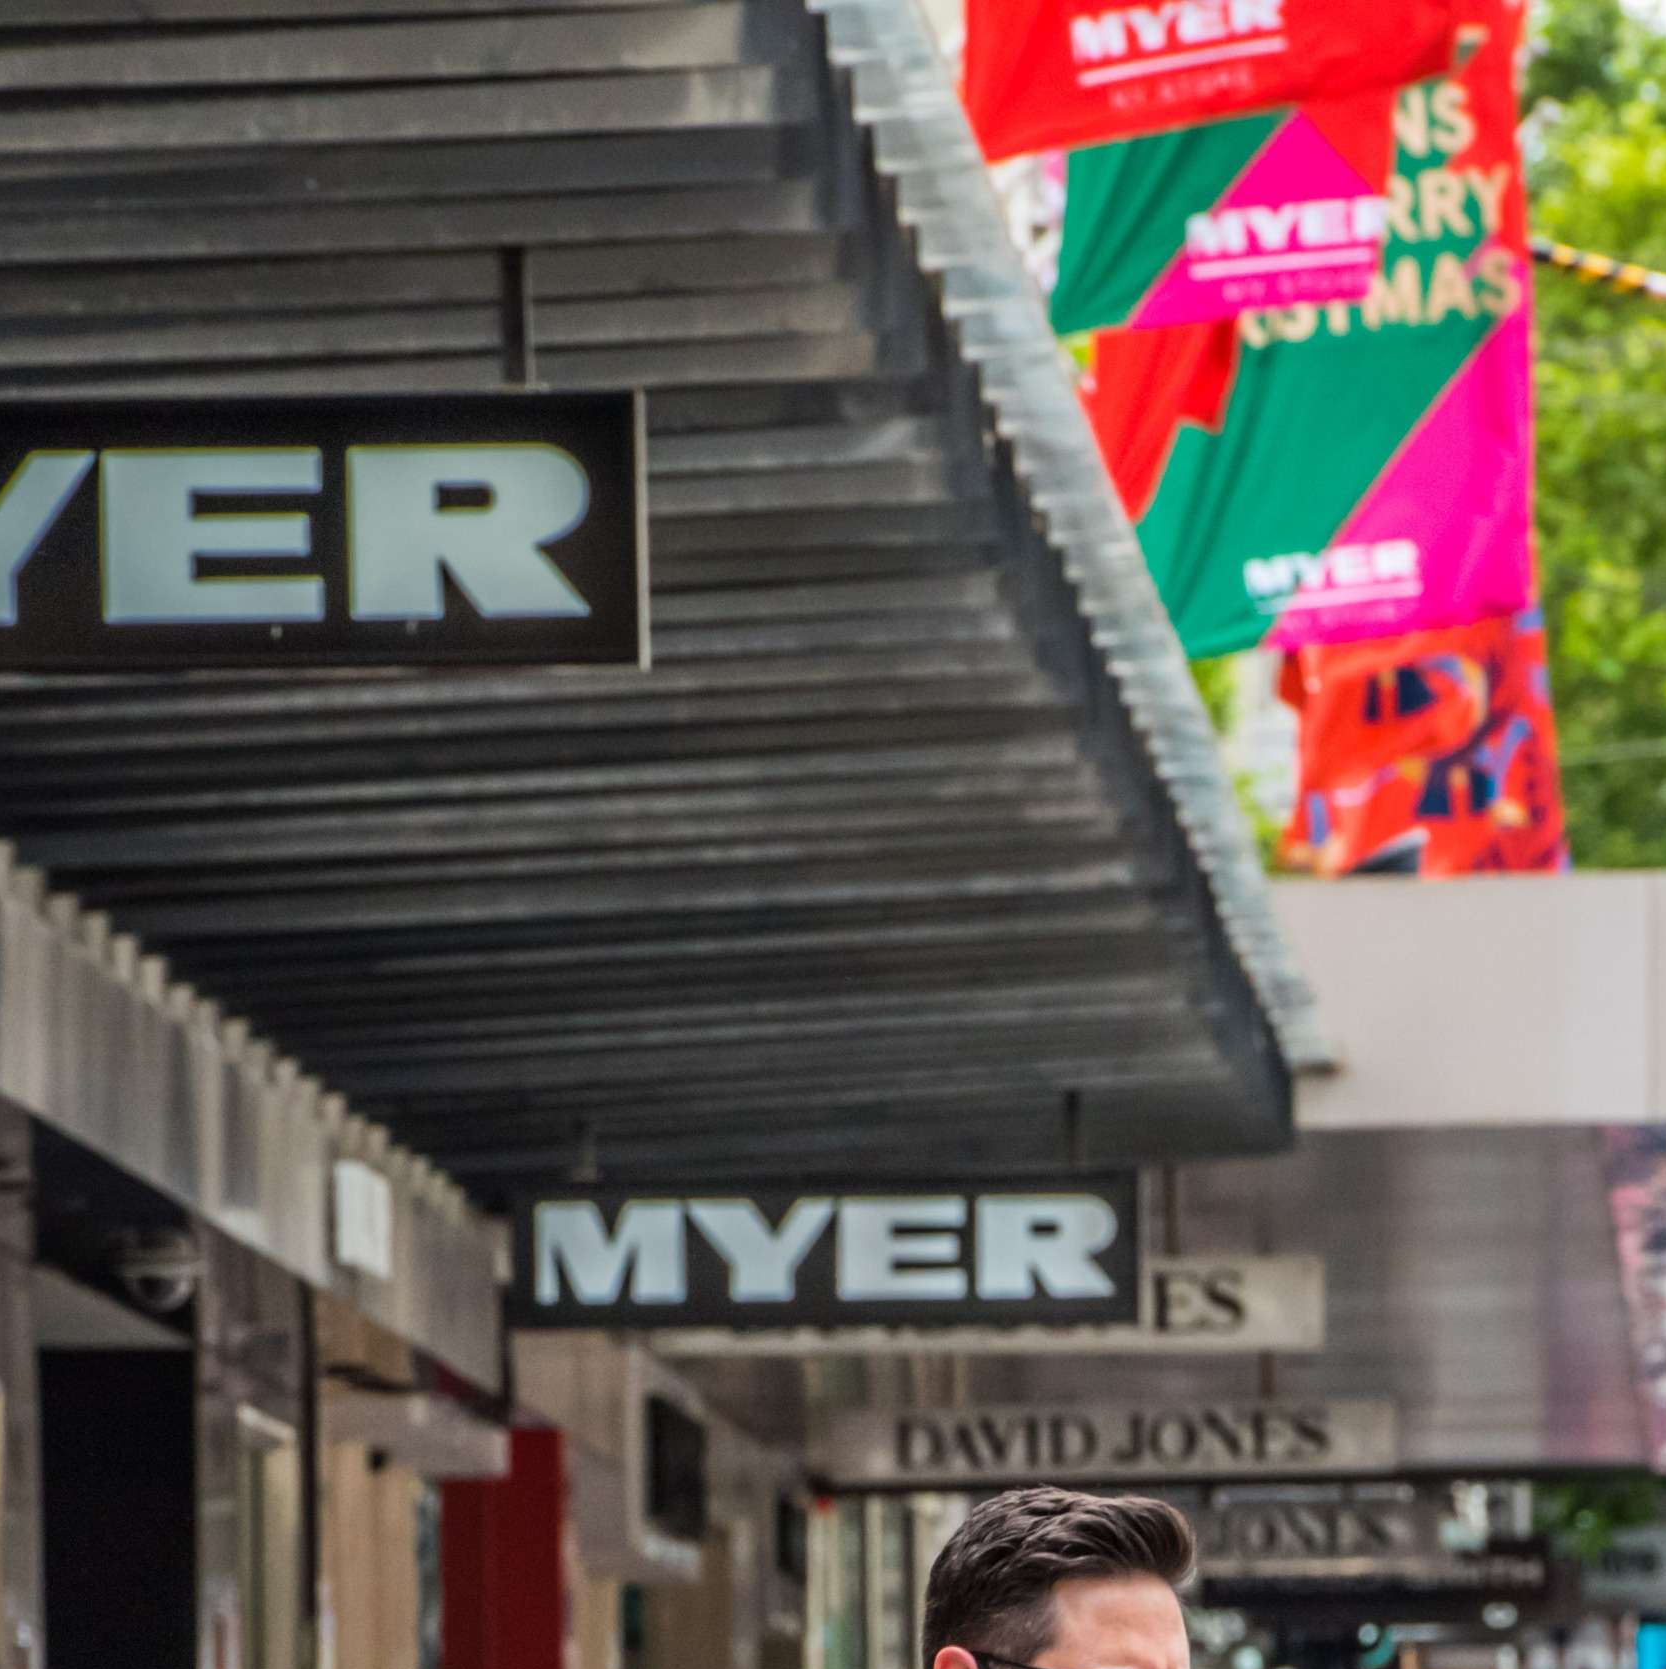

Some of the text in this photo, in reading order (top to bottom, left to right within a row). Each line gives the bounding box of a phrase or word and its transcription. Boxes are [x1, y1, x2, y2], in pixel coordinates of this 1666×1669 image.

[1070, 0, 1283, 63] MYER
[1243, 538, 1420, 599] MYER
[534, 1193, 1118, 1307] MYER
[896, 1408, 1331, 1470] DAVID JONES
